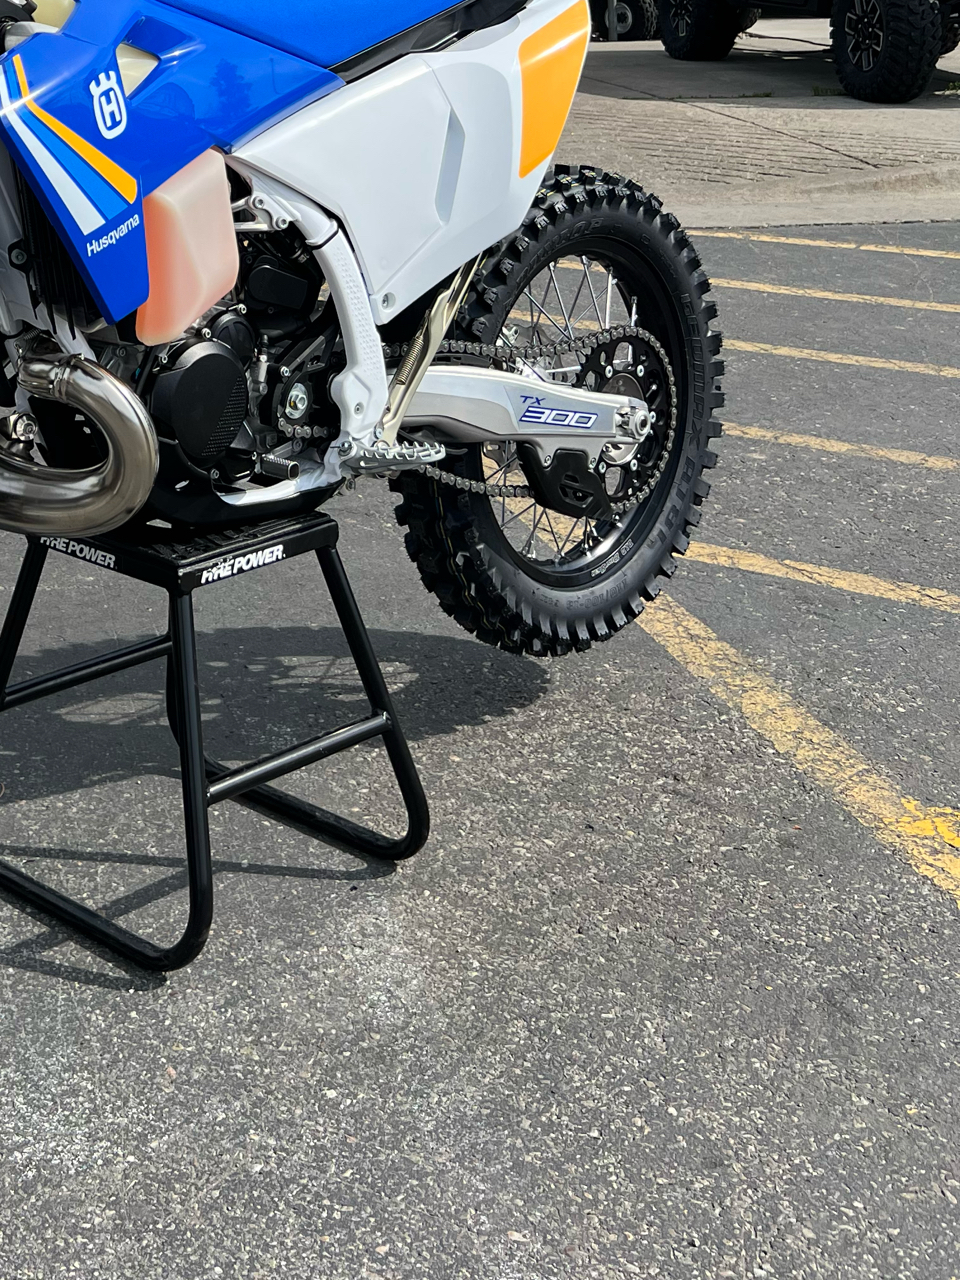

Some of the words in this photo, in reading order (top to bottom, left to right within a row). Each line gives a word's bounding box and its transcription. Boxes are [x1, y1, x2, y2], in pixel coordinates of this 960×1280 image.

[86, 213, 140, 257] Husqvarna
[520, 395, 546, 405] TX
[519, 405, 598, 429] 300
